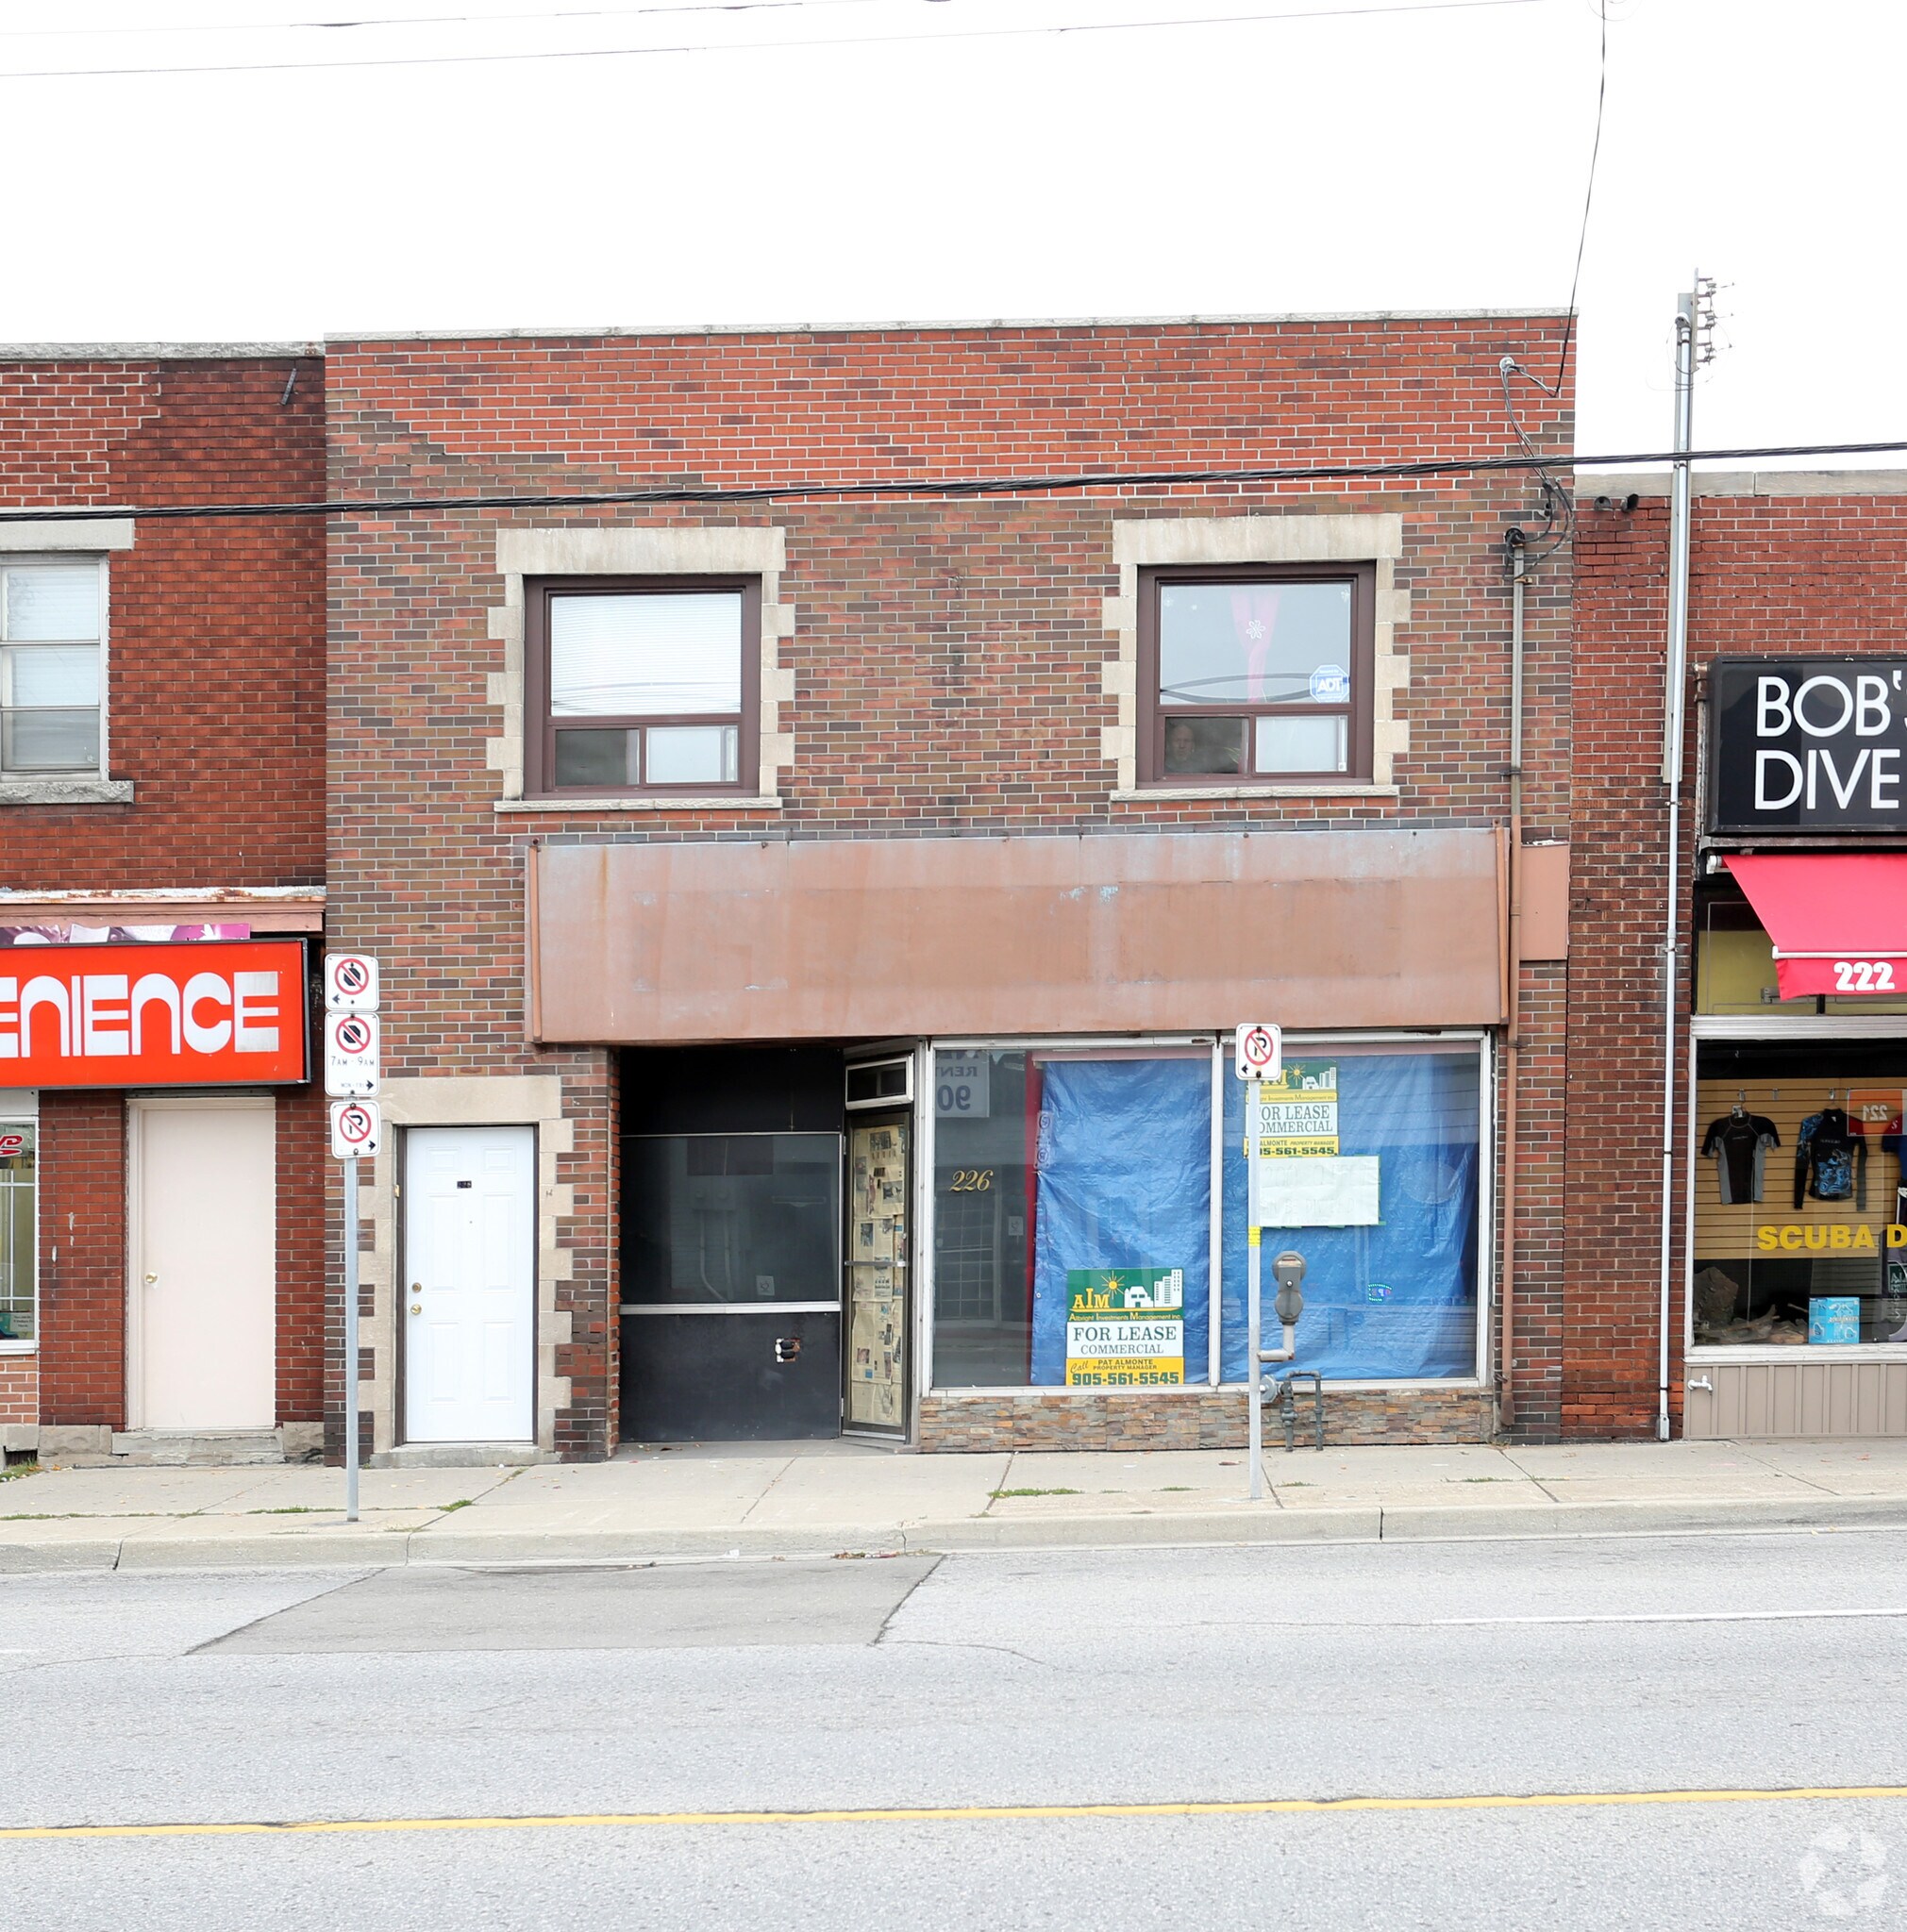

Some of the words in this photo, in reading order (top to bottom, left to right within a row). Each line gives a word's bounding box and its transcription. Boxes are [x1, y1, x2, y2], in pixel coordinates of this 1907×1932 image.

[1318, 677, 1341, 691] ADT
[1756, 670, 1907, 737] BOB'
[1755, 749, 1900, 810] DIVE
[1833, 961, 1895, 991] 222
[330, 1056, 348, 1066] 7AM
[357, 1056, 375, 1066] 9AM
[1259, 1106, 1280, 1121] OR
[1285, 1105, 1330, 1120] LEASE
[1260, 1121, 1333, 1134] OMMERCIAL
[949, 1170, 994, 1192] 226
[1757, 1224, 1875, 1250] SCUBA
[1887, 1224, 1907, 1247] D
[1072, 1288, 1110, 1309] AIM
[1074, 1326, 1112, 1341] FOR
[1117, 1325, 1177, 1341] LEASE
[1080, 1343, 1164, 1355] COMMERCIAL
[1070, 1360, 1089, 1374] Call
[1072, 1372, 1179, 1386] 905-561-5545
